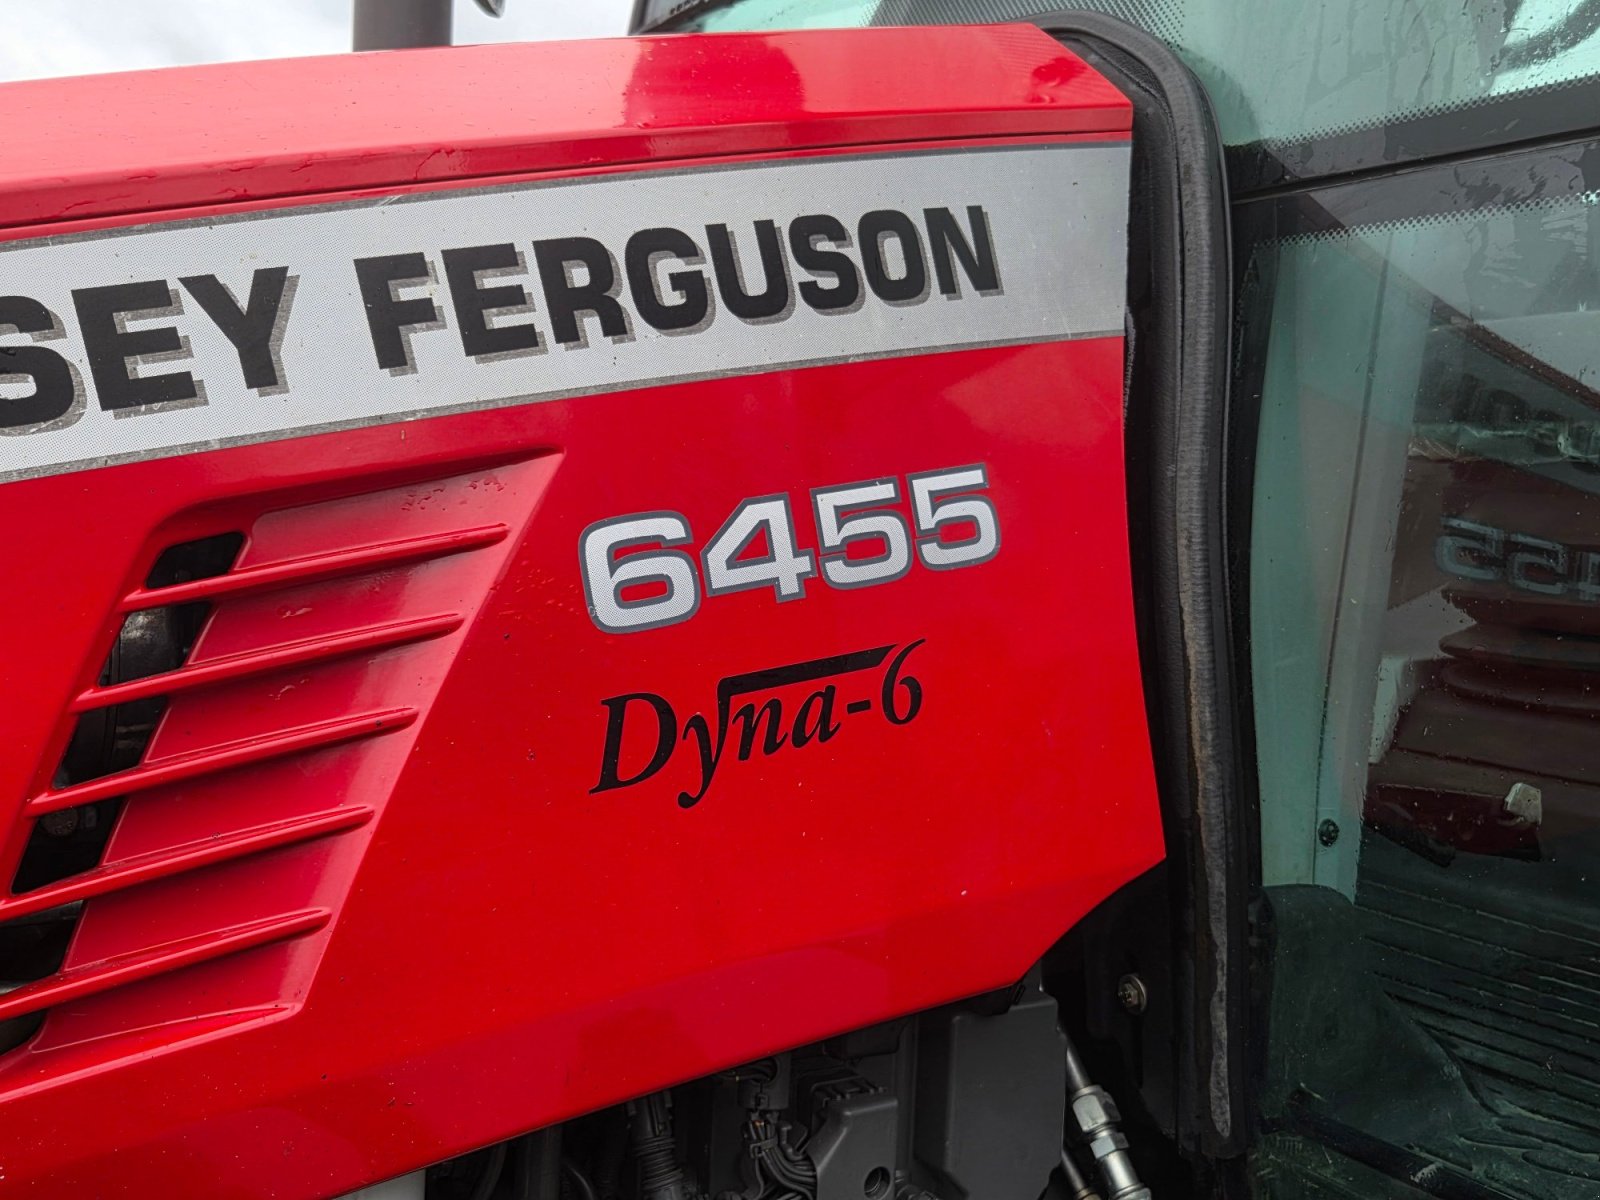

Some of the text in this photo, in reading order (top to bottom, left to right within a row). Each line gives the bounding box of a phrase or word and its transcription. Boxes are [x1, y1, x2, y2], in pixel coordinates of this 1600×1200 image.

[353, 204, 1004, 377] FERGUSON
[578, 462, 1001, 635] 6455
[588, 638, 926, 810] Dyna-6
